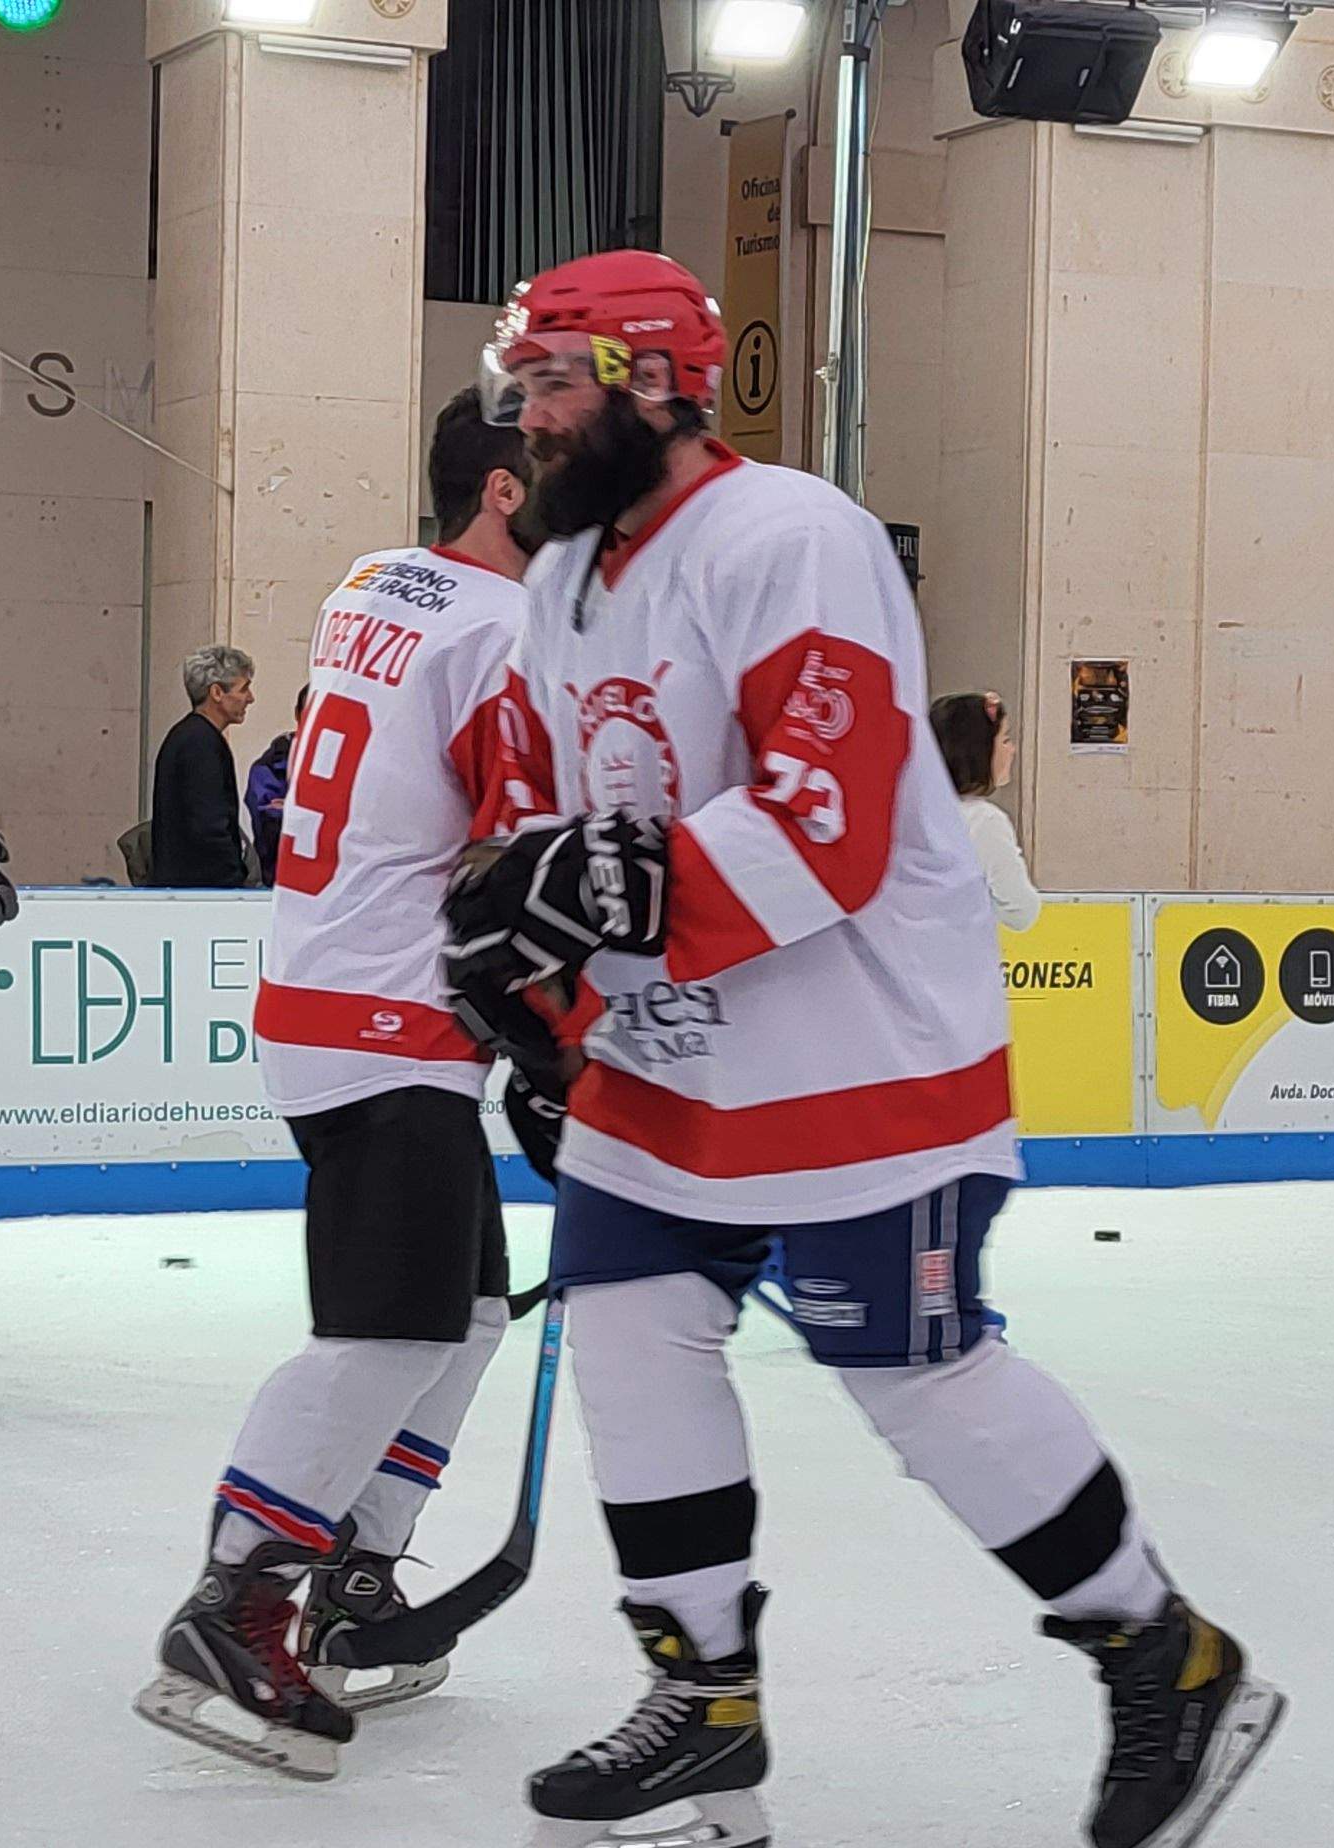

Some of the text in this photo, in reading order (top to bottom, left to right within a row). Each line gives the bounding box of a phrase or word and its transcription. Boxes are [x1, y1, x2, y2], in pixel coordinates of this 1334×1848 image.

[741, 176, 780, 200] Oficina
[767, 203, 780, 222] de
[735, 234, 780, 256] Turismo
[1208, 994, 1239, 1007] FIBRA
[1270, 1084, 1307, 1100] Avda.
